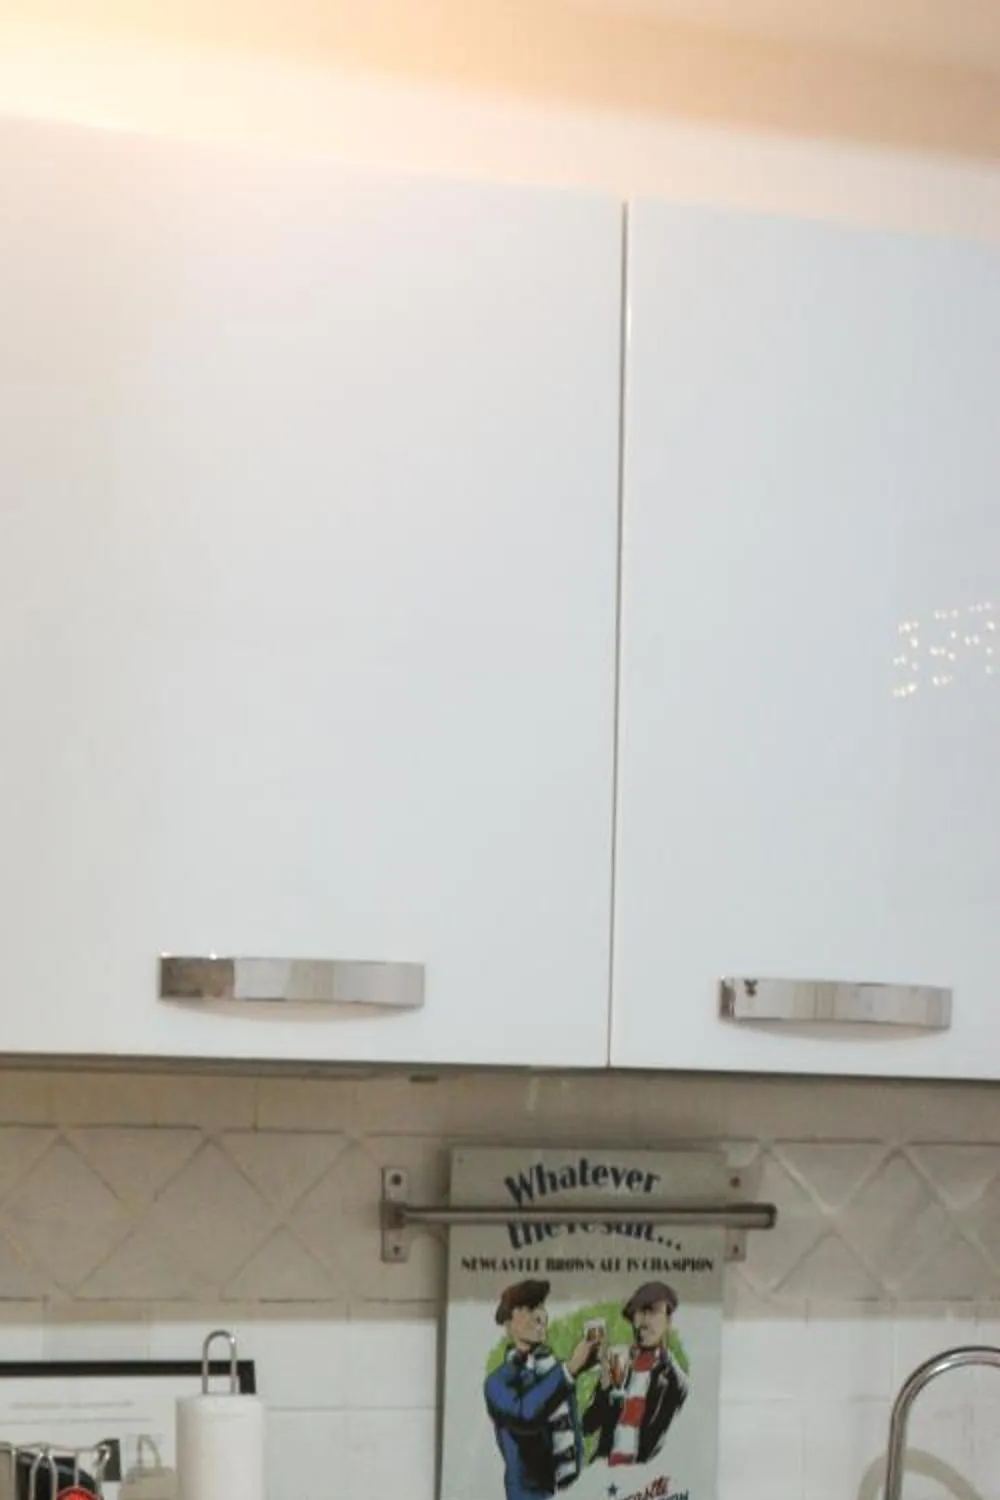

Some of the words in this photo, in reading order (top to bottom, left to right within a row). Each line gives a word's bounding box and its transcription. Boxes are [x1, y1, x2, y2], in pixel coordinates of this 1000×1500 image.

[504, 1157, 661, 1208] Whatever
[461, 1256, 540, 1273] NEWCASTLE
[546, 1256, 595, 1273] BROWN
[600, 1256, 621, 1273] ALE
[627, 1256, 640, 1273] IS
[641, 1256, 714, 1273] CHAMPION
